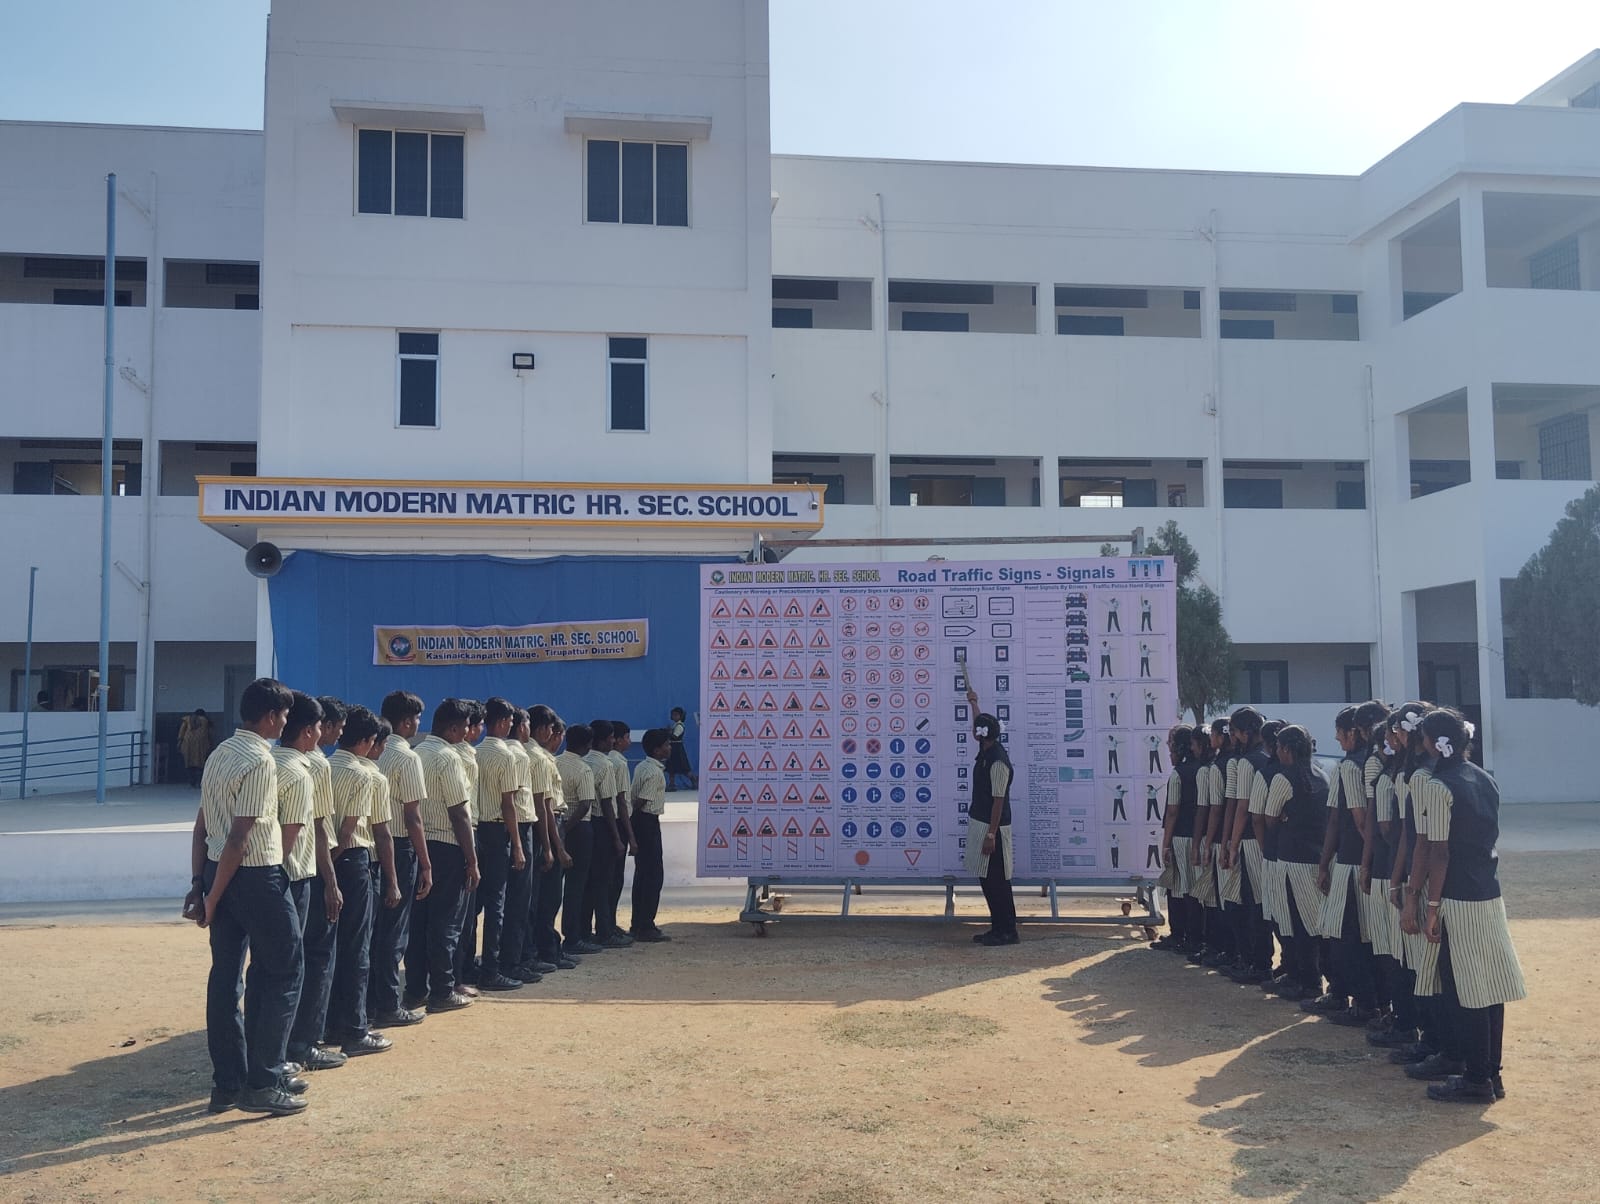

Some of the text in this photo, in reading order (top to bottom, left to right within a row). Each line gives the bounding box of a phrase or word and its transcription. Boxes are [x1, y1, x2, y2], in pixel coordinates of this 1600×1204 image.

[224, 489, 798, 517] INDIAN MODERN MATRIC HR. SEC. SCHOOL
[729, 571, 753, 583] INDIAN
[755, 571, 785, 583] MODERN
[852, 569, 881, 582] SCHOOL
[898, 569, 936, 582] Road
[941, 568, 993, 581] Traffic
[998, 567, 1041, 584] Signs
[1056, 565, 1116, 582] Signals
[418, 630, 640, 650] INDIAN MODERN MATRIC. HR. SEC. SCHOOL
[545, 648, 588, 657] Tirupattur
[591, 646, 625, 655] District
